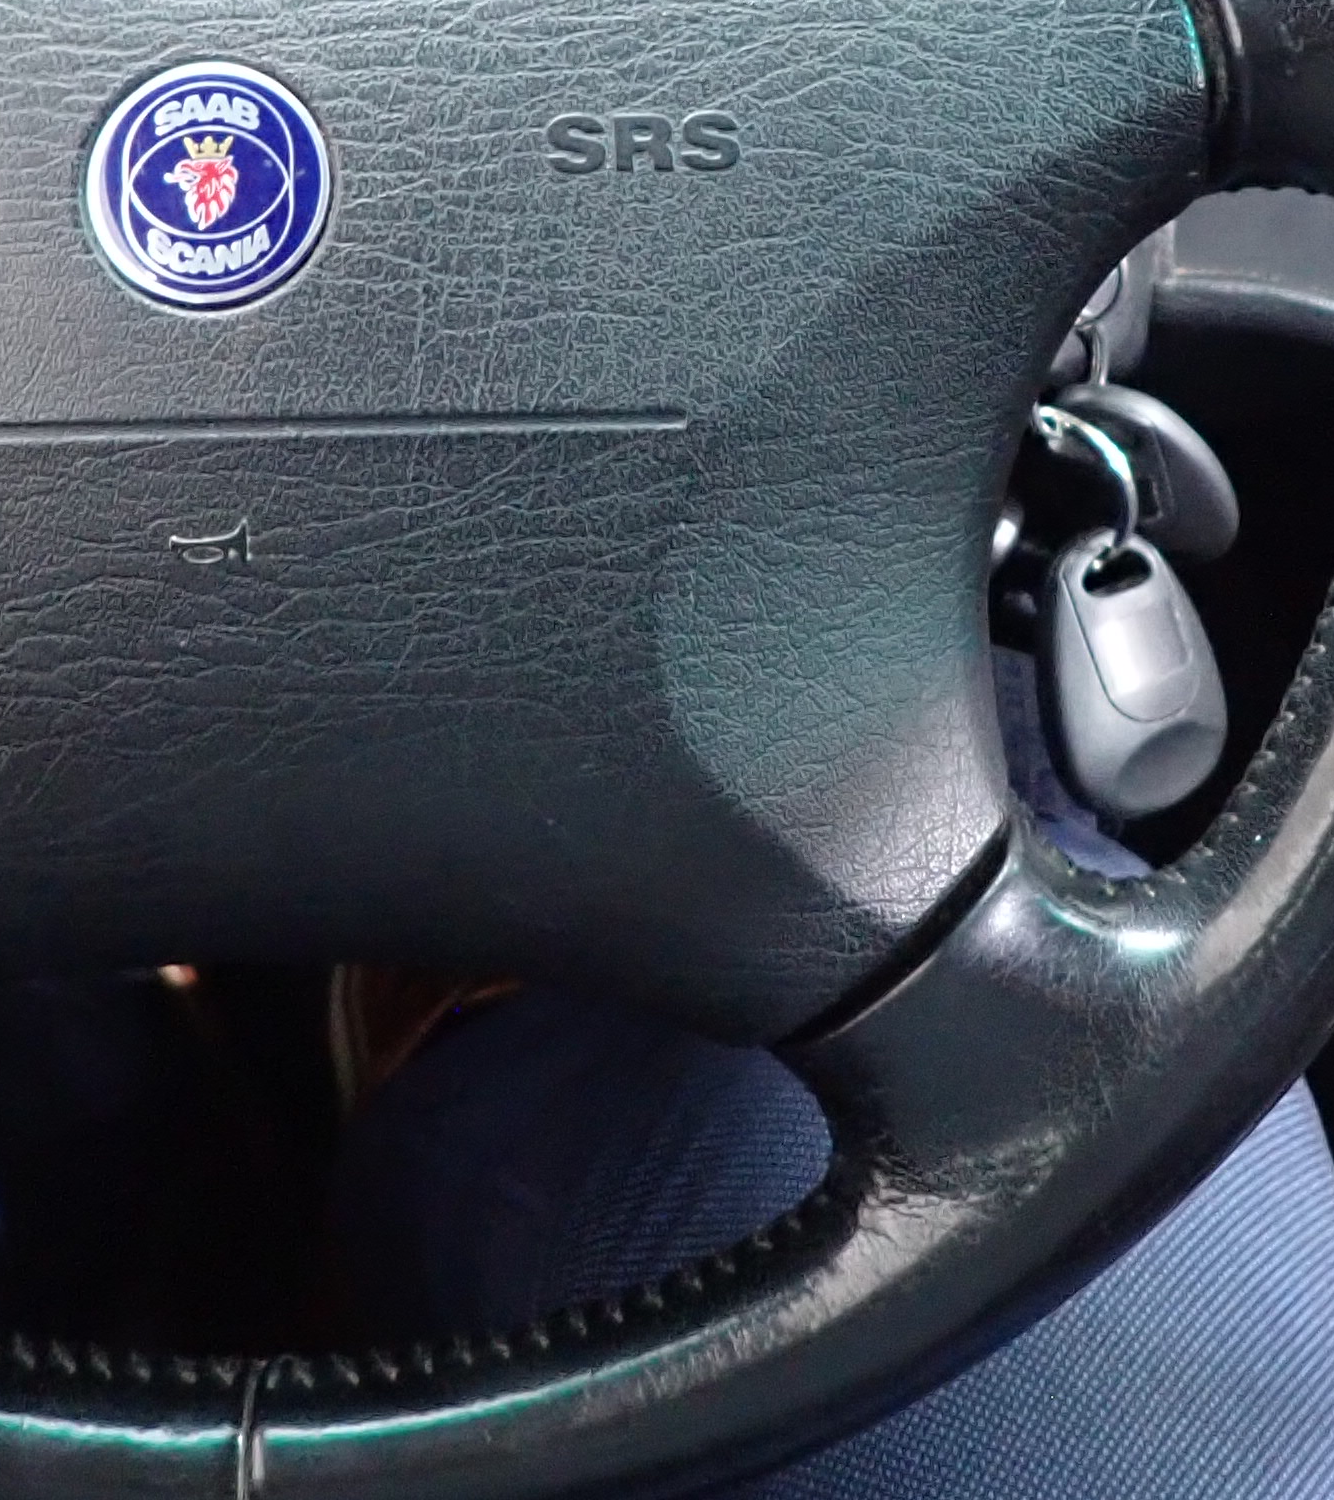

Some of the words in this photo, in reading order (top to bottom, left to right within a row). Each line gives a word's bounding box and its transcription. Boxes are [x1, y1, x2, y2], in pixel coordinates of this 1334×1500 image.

[154, 92, 260, 137] SAAB
[546, 112, 741, 175] SRS
[146, 223, 271, 277] SCANIA
